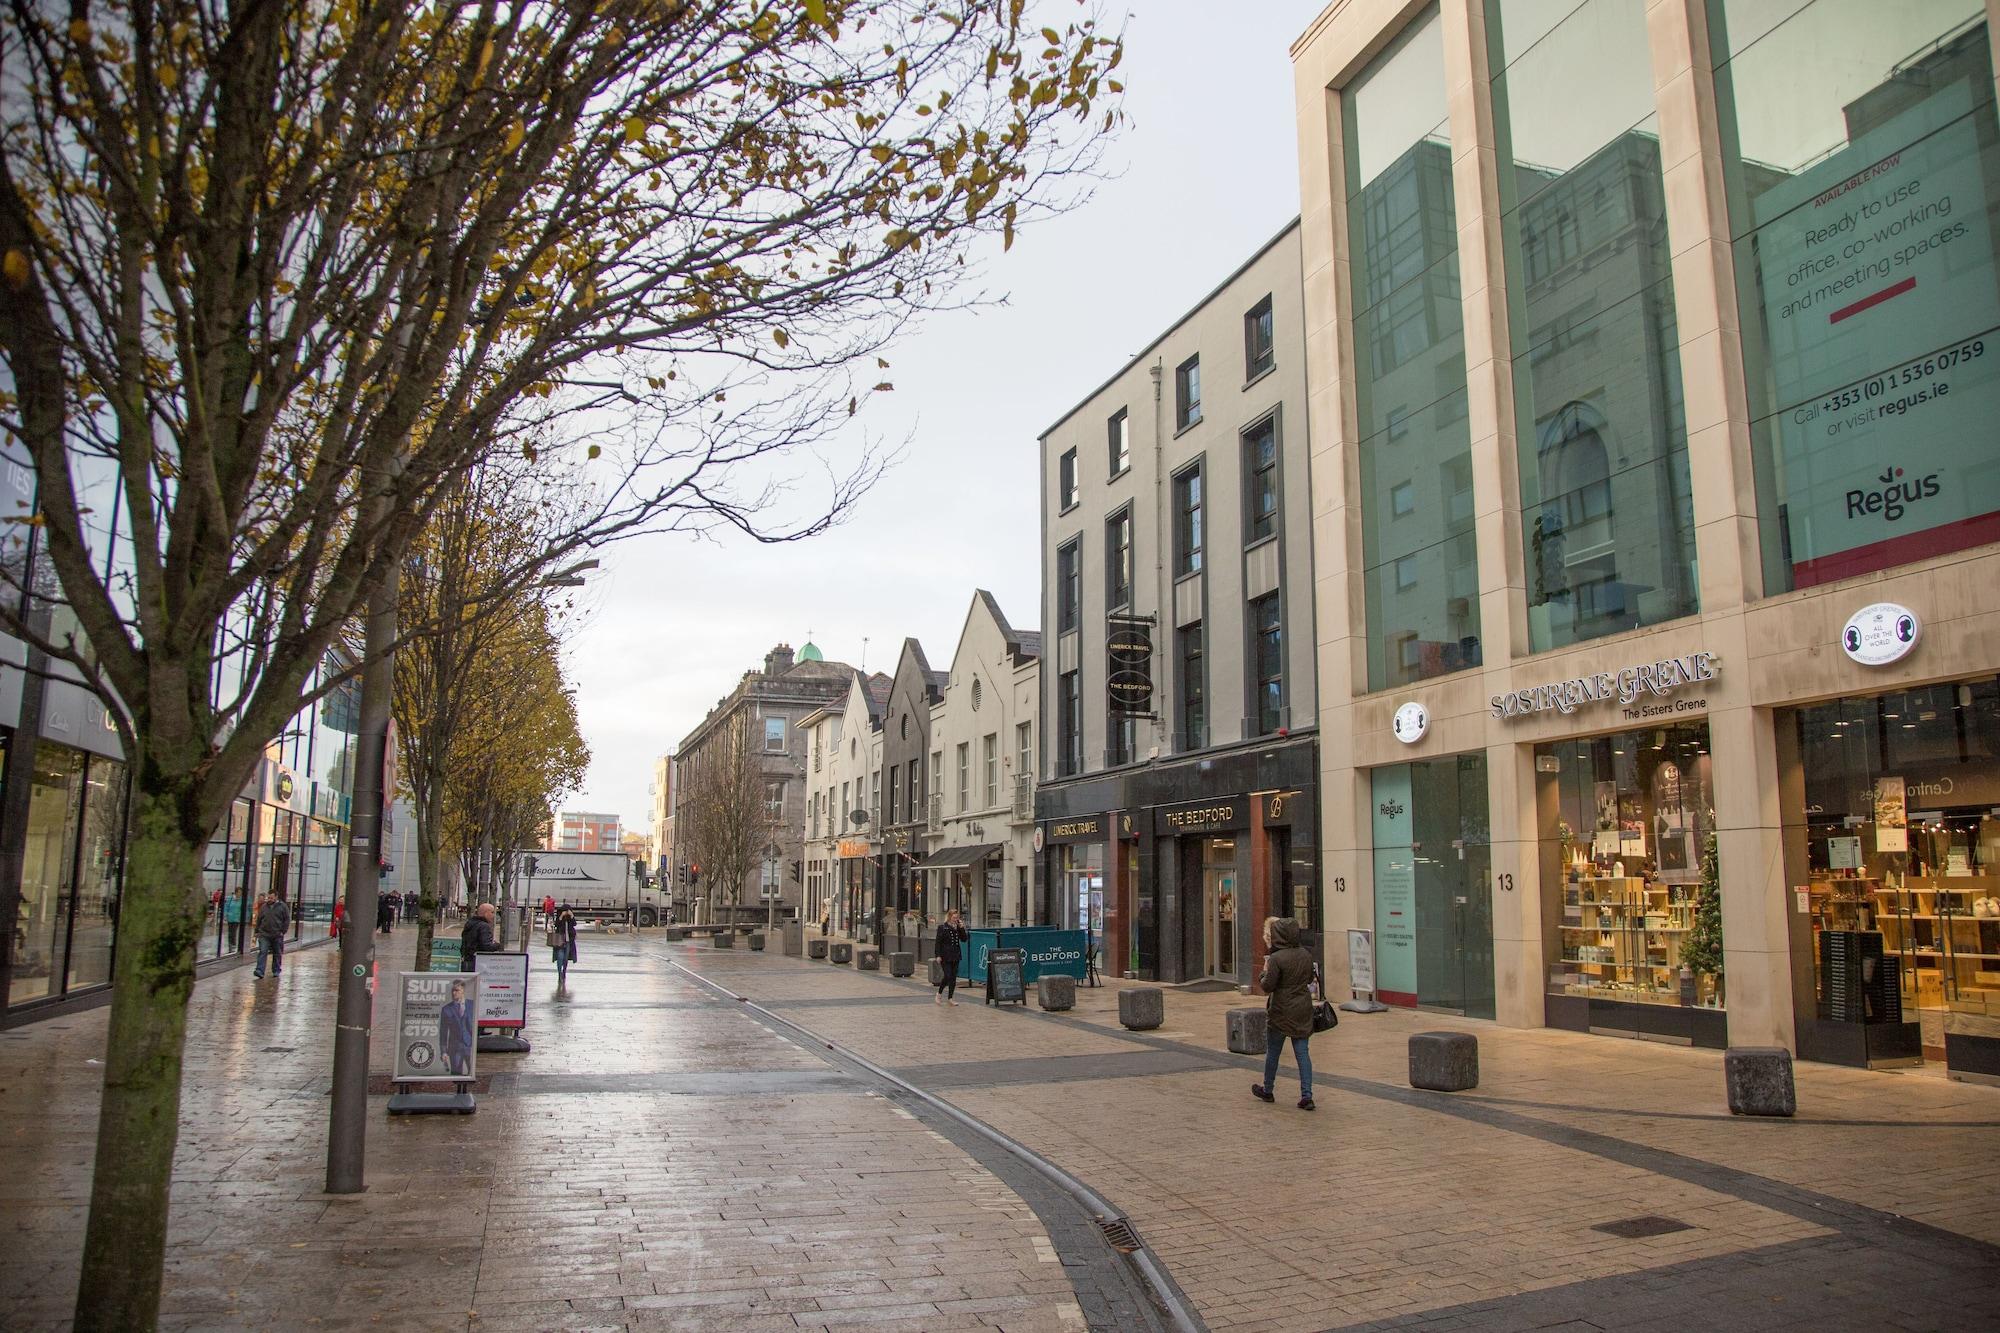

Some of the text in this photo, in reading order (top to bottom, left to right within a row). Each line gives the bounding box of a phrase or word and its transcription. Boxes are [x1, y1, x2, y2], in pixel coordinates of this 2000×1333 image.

[1814, 154, 1901, 209] AVAILABLE NOW
[1805, 179, 1921, 248] Ready to use
[1787, 196, 1952, 287] office, co-working
[1781, 222, 1969, 319] and meeting spaces.
[1794, 340, 1985, 425] Call +353 (0) 1 536 0759
[1827, 382, 1949, 436] or visit regus.ie
[1846, 470, 1941, 521] Regus
[1869, 639, 1890, 647] WORLD
[1615, 651, 1715, 705] GRENE
[1623, 698, 1707, 721] The Sisters Grene
[1166, 806, 1233, 826] THE BEDFORD
[1380, 802, 1404, 819] Regus
[561, 866, 577, 875] Ltd
[1334, 877, 1346, 892] 13
[1498, 873, 1513, 891] 13
[1031, 951, 1080, 961] BEDFORD
[408, 979, 450, 993] SUIT
[486, 1007, 508, 1017] Regus
[404, 1025, 439, 1036] €179
